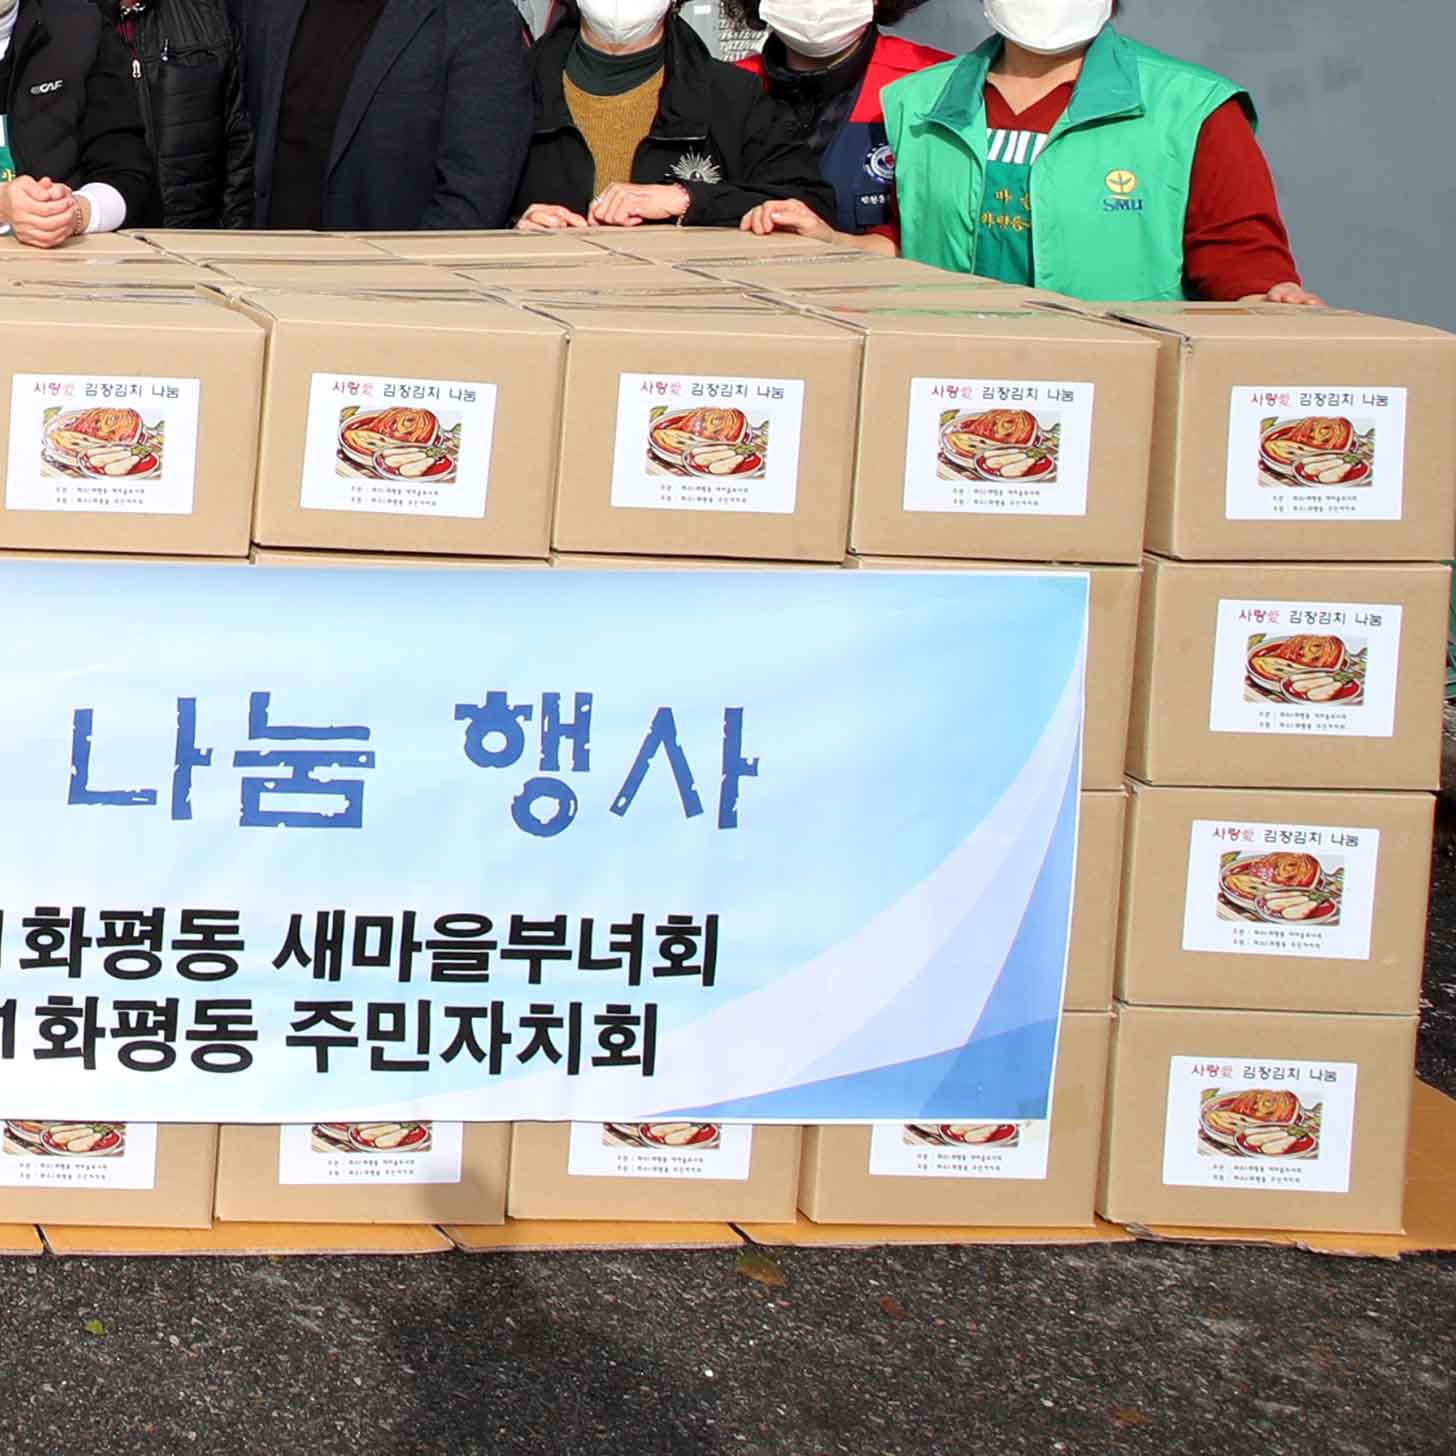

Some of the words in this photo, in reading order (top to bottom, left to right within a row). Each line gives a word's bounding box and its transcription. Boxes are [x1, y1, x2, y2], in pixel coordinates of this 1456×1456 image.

[84, 382, 142, 398] 김장김치
[151, 383, 179, 399] 나눔
[383, 383, 440, 400] 김장김치
[448, 386, 476, 402] 나눔
[690, 381, 748, 398] 김장김치
[756, 384, 784, 399] 나눔
[981, 383, 1038, 400] 김장김치
[1046, 388, 1074, 402] 나눔
[1299, 392, 1354, 407] 김장김치
[1361, 393, 1388, 407] 나눔
[1289, 609, 1346, 625] 김장김치
[1354, 612, 1382, 627] 나눔
[65, 691, 377, 830] 나눔
[453, 690, 760, 838] 행사
[1263, 828, 1322, 845] 김장김치
[1330, 832, 1359, 847] 나눔
[274, 911, 718, 986] 새마을부녀회
[287, 1000, 657, 1075] 주민자치회
[1242, 1065, 1300, 1080] 김장김치
[1308, 1068, 1337, 1082] 나눔
